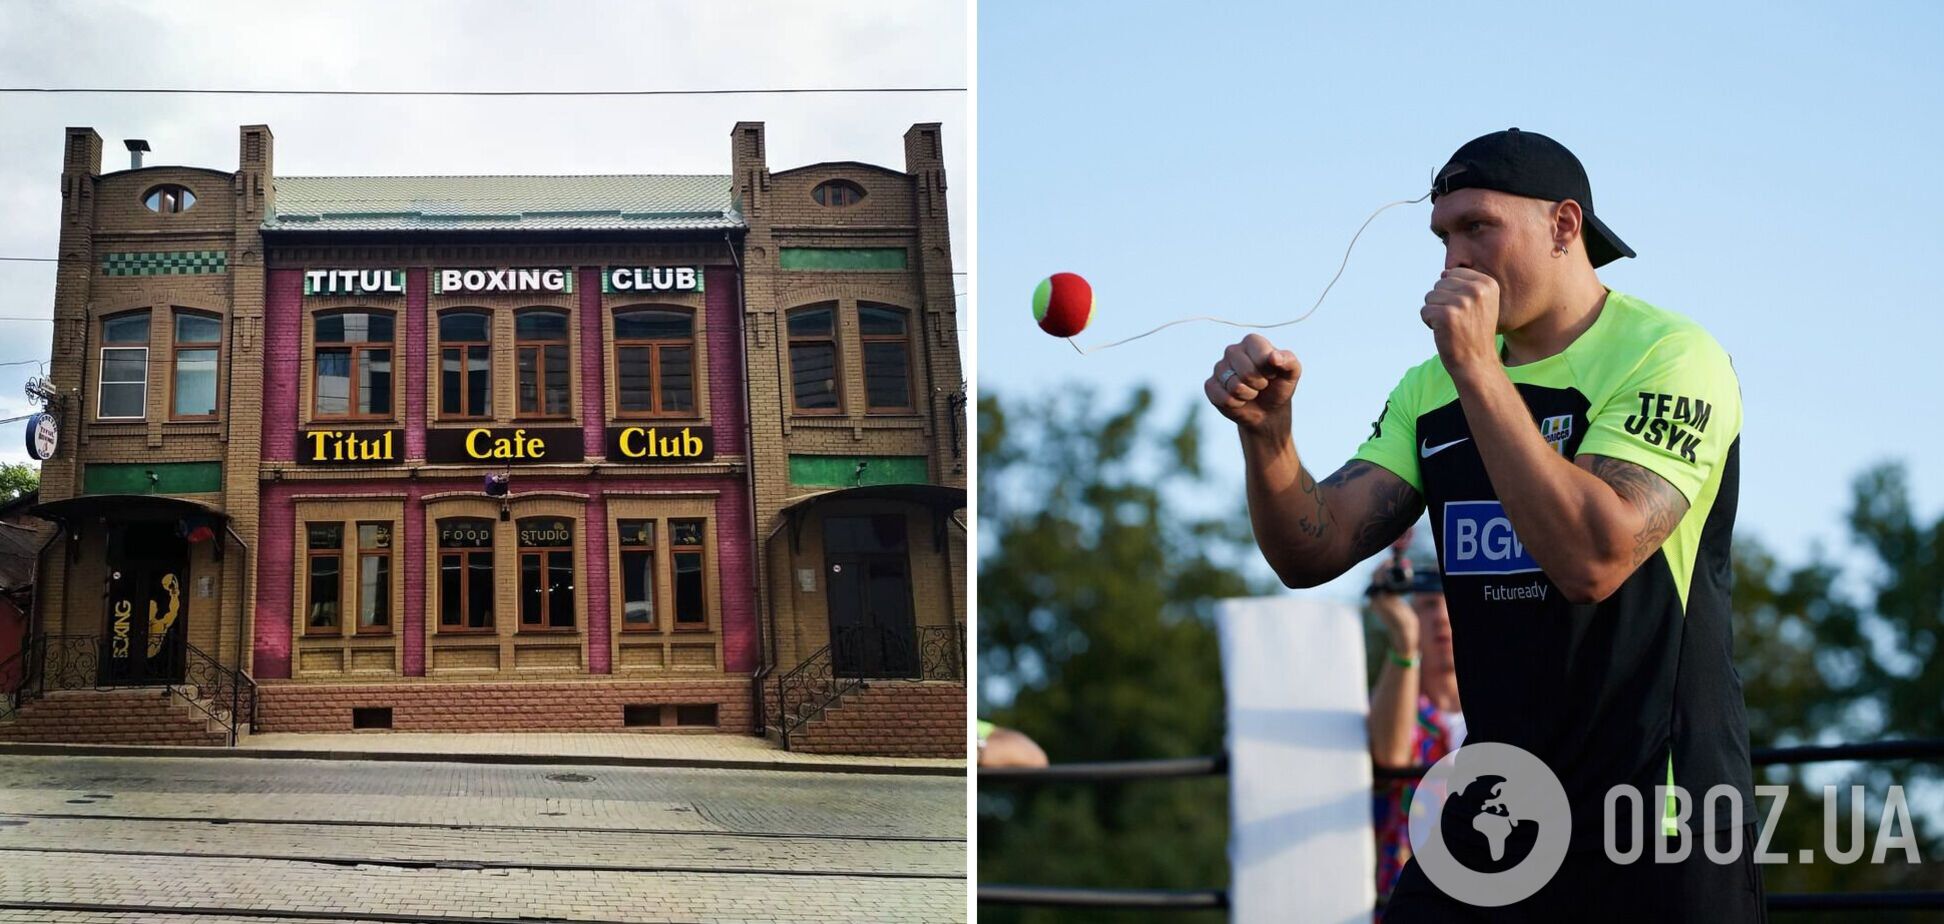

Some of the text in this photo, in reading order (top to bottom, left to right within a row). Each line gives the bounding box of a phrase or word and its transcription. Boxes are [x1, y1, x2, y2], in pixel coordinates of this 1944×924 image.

[307, 267, 698, 293] TITUL BOXING CLUB
[1638, 392, 1712, 433] TEAM
[307, 426, 703, 461] Titul Cafe Club
[1624, 414, 1702, 464] USYK
[443, 530, 569, 540] FOOD STUDIO
[1484, 581, 1548, 601] Futuready
